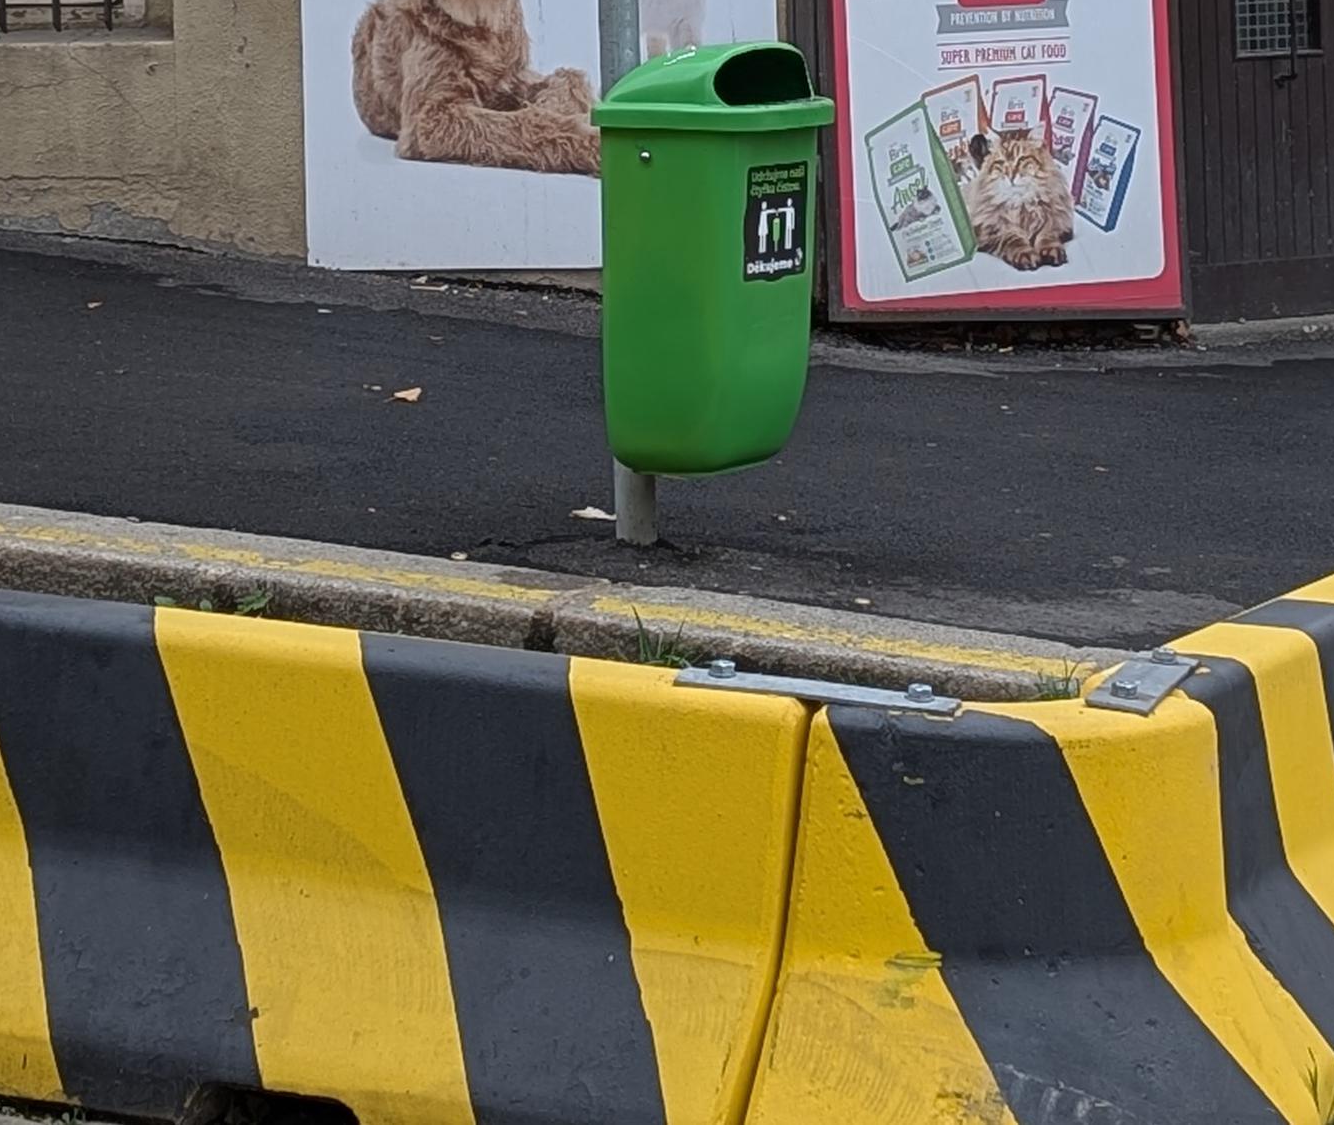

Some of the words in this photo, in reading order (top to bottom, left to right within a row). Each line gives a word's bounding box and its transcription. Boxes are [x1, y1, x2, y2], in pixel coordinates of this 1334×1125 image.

[950, 10, 998, 26] PREVENTION
[1001, 9, 1012, 22] BY
[940, 49, 971, 66] SUPER
[974, 46, 1017, 63] PREMIUM
[1020, 44, 1037, 60] CAT
[1041, 43, 1067, 58] FOOD
